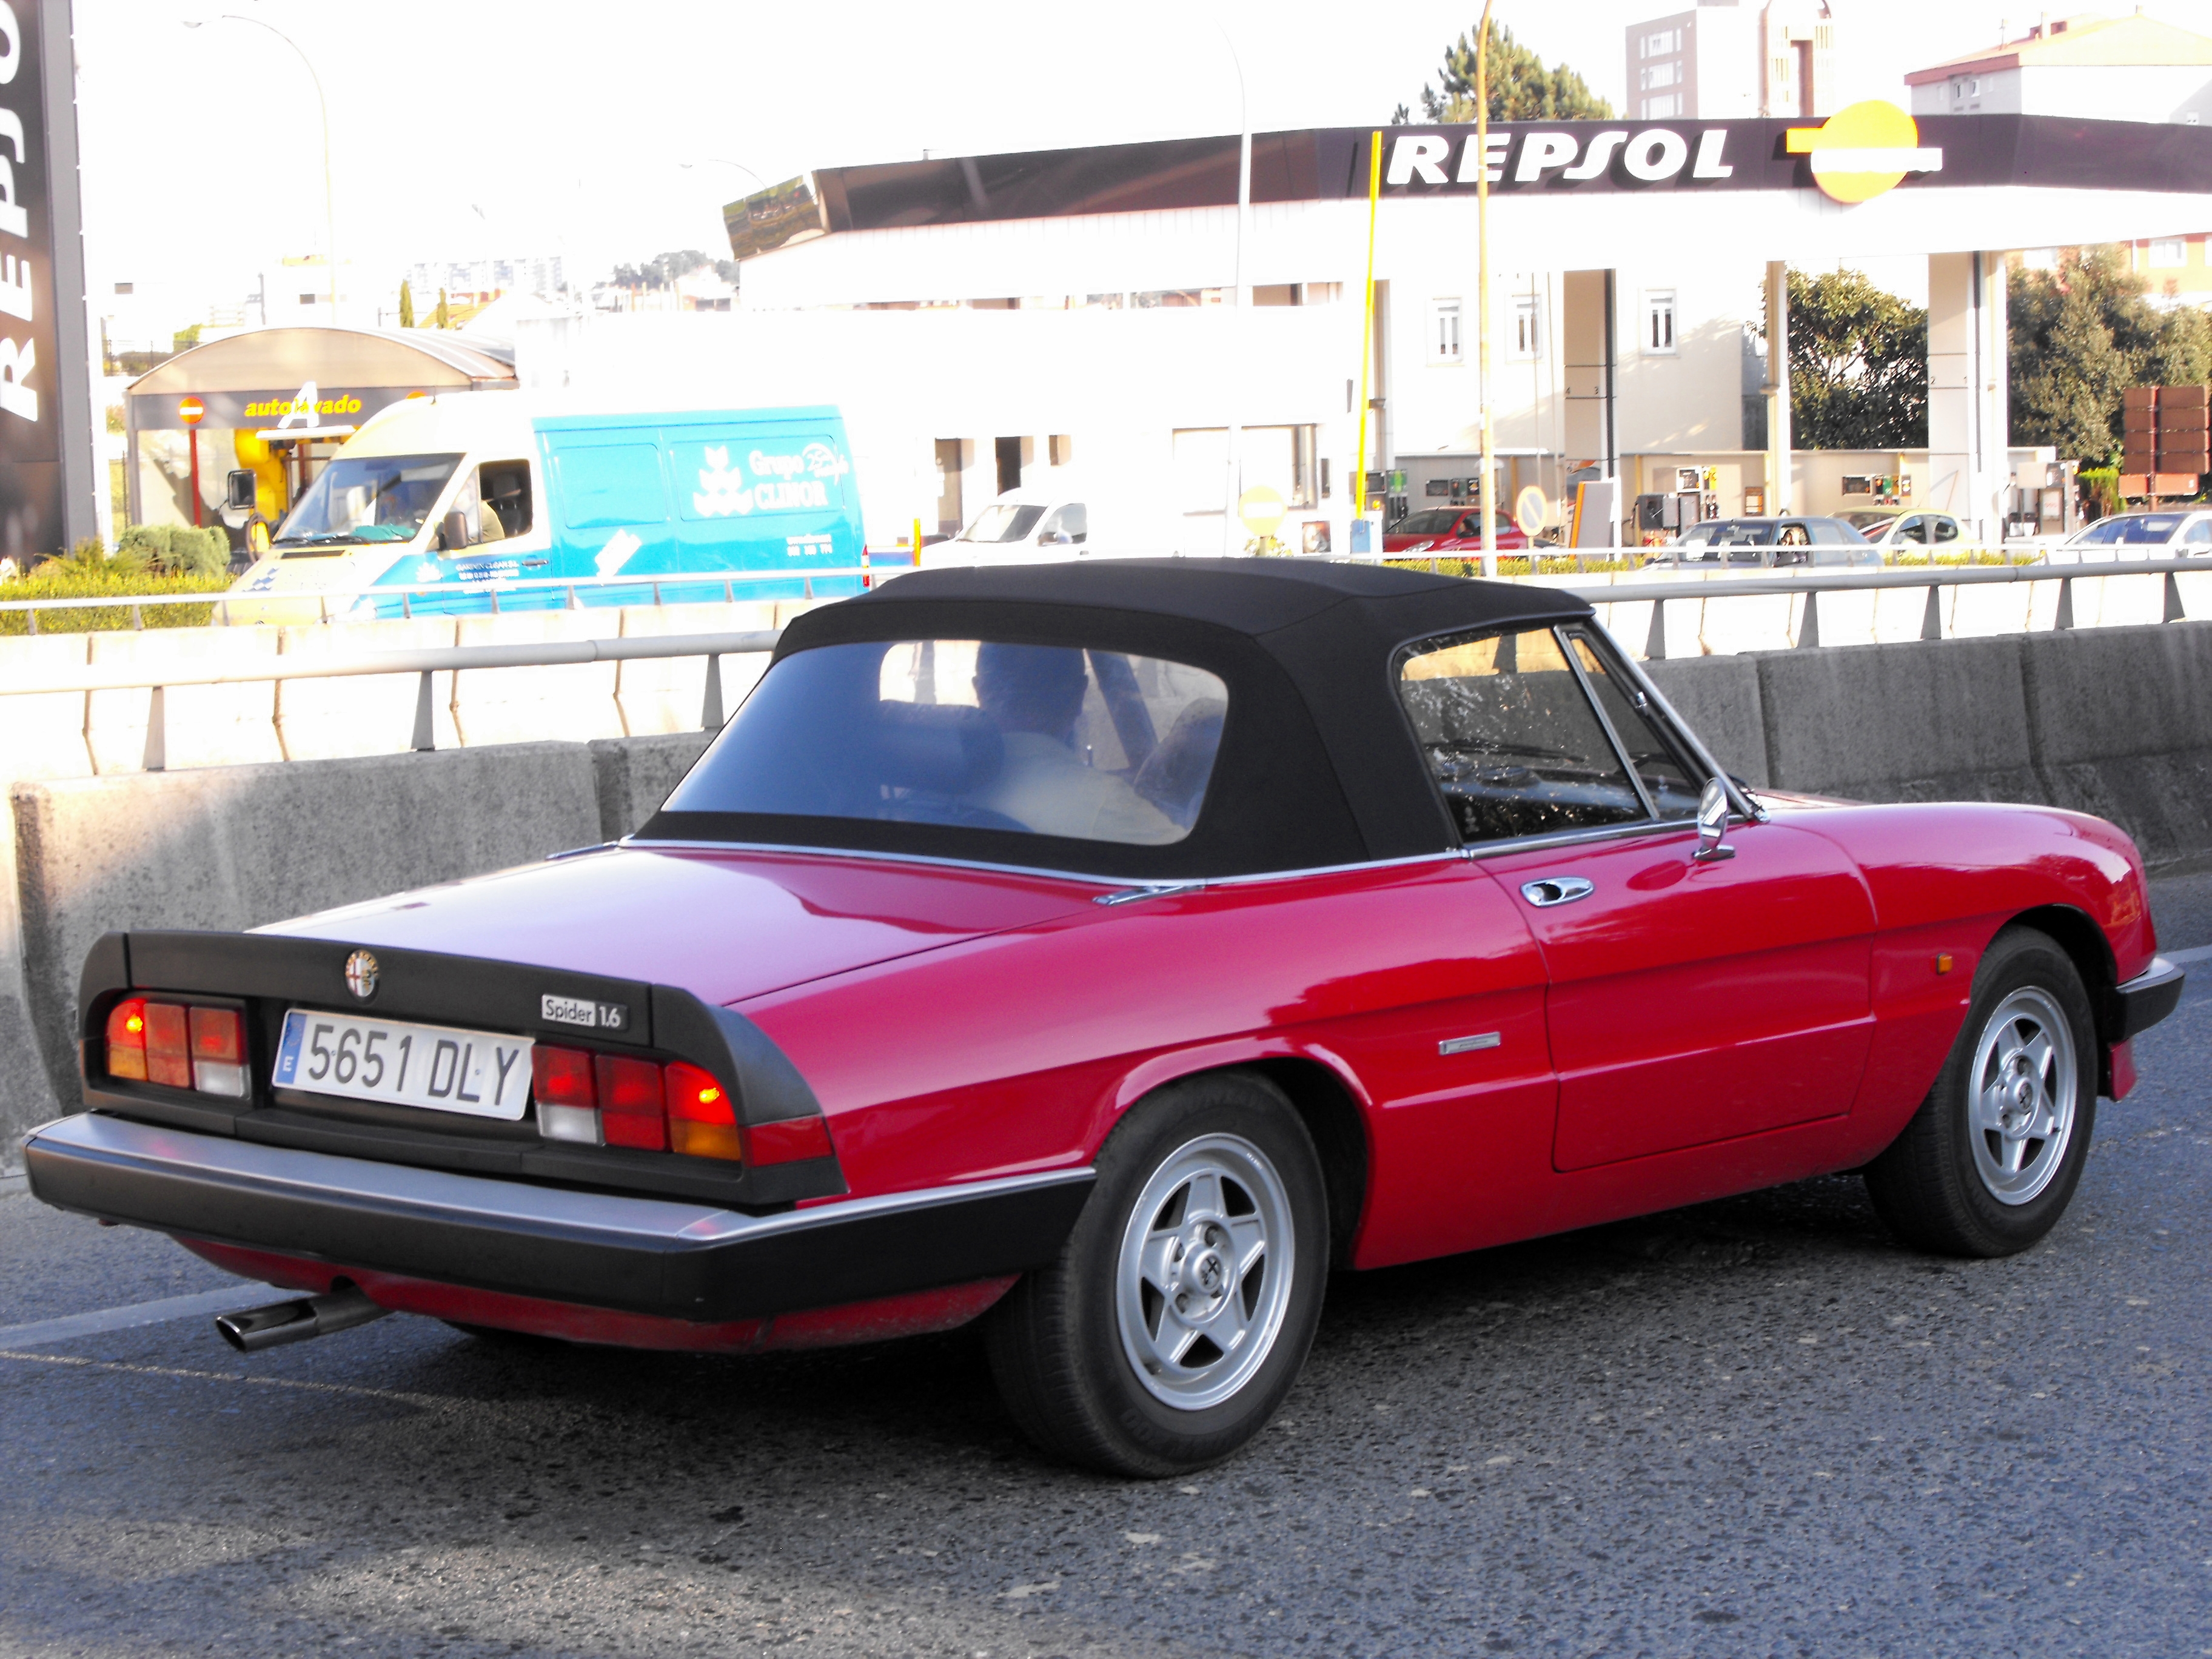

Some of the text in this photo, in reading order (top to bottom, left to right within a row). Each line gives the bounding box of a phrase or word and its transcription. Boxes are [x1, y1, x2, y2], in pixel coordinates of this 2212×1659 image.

[1387, 128, 1733, 185] REPSOL
[749, 450, 805, 481] Grupo
[546, 999, 592, 1022] Spider
[283, 1055, 294, 1073] E
[308, 1024, 520, 1106] 5651 DLY
